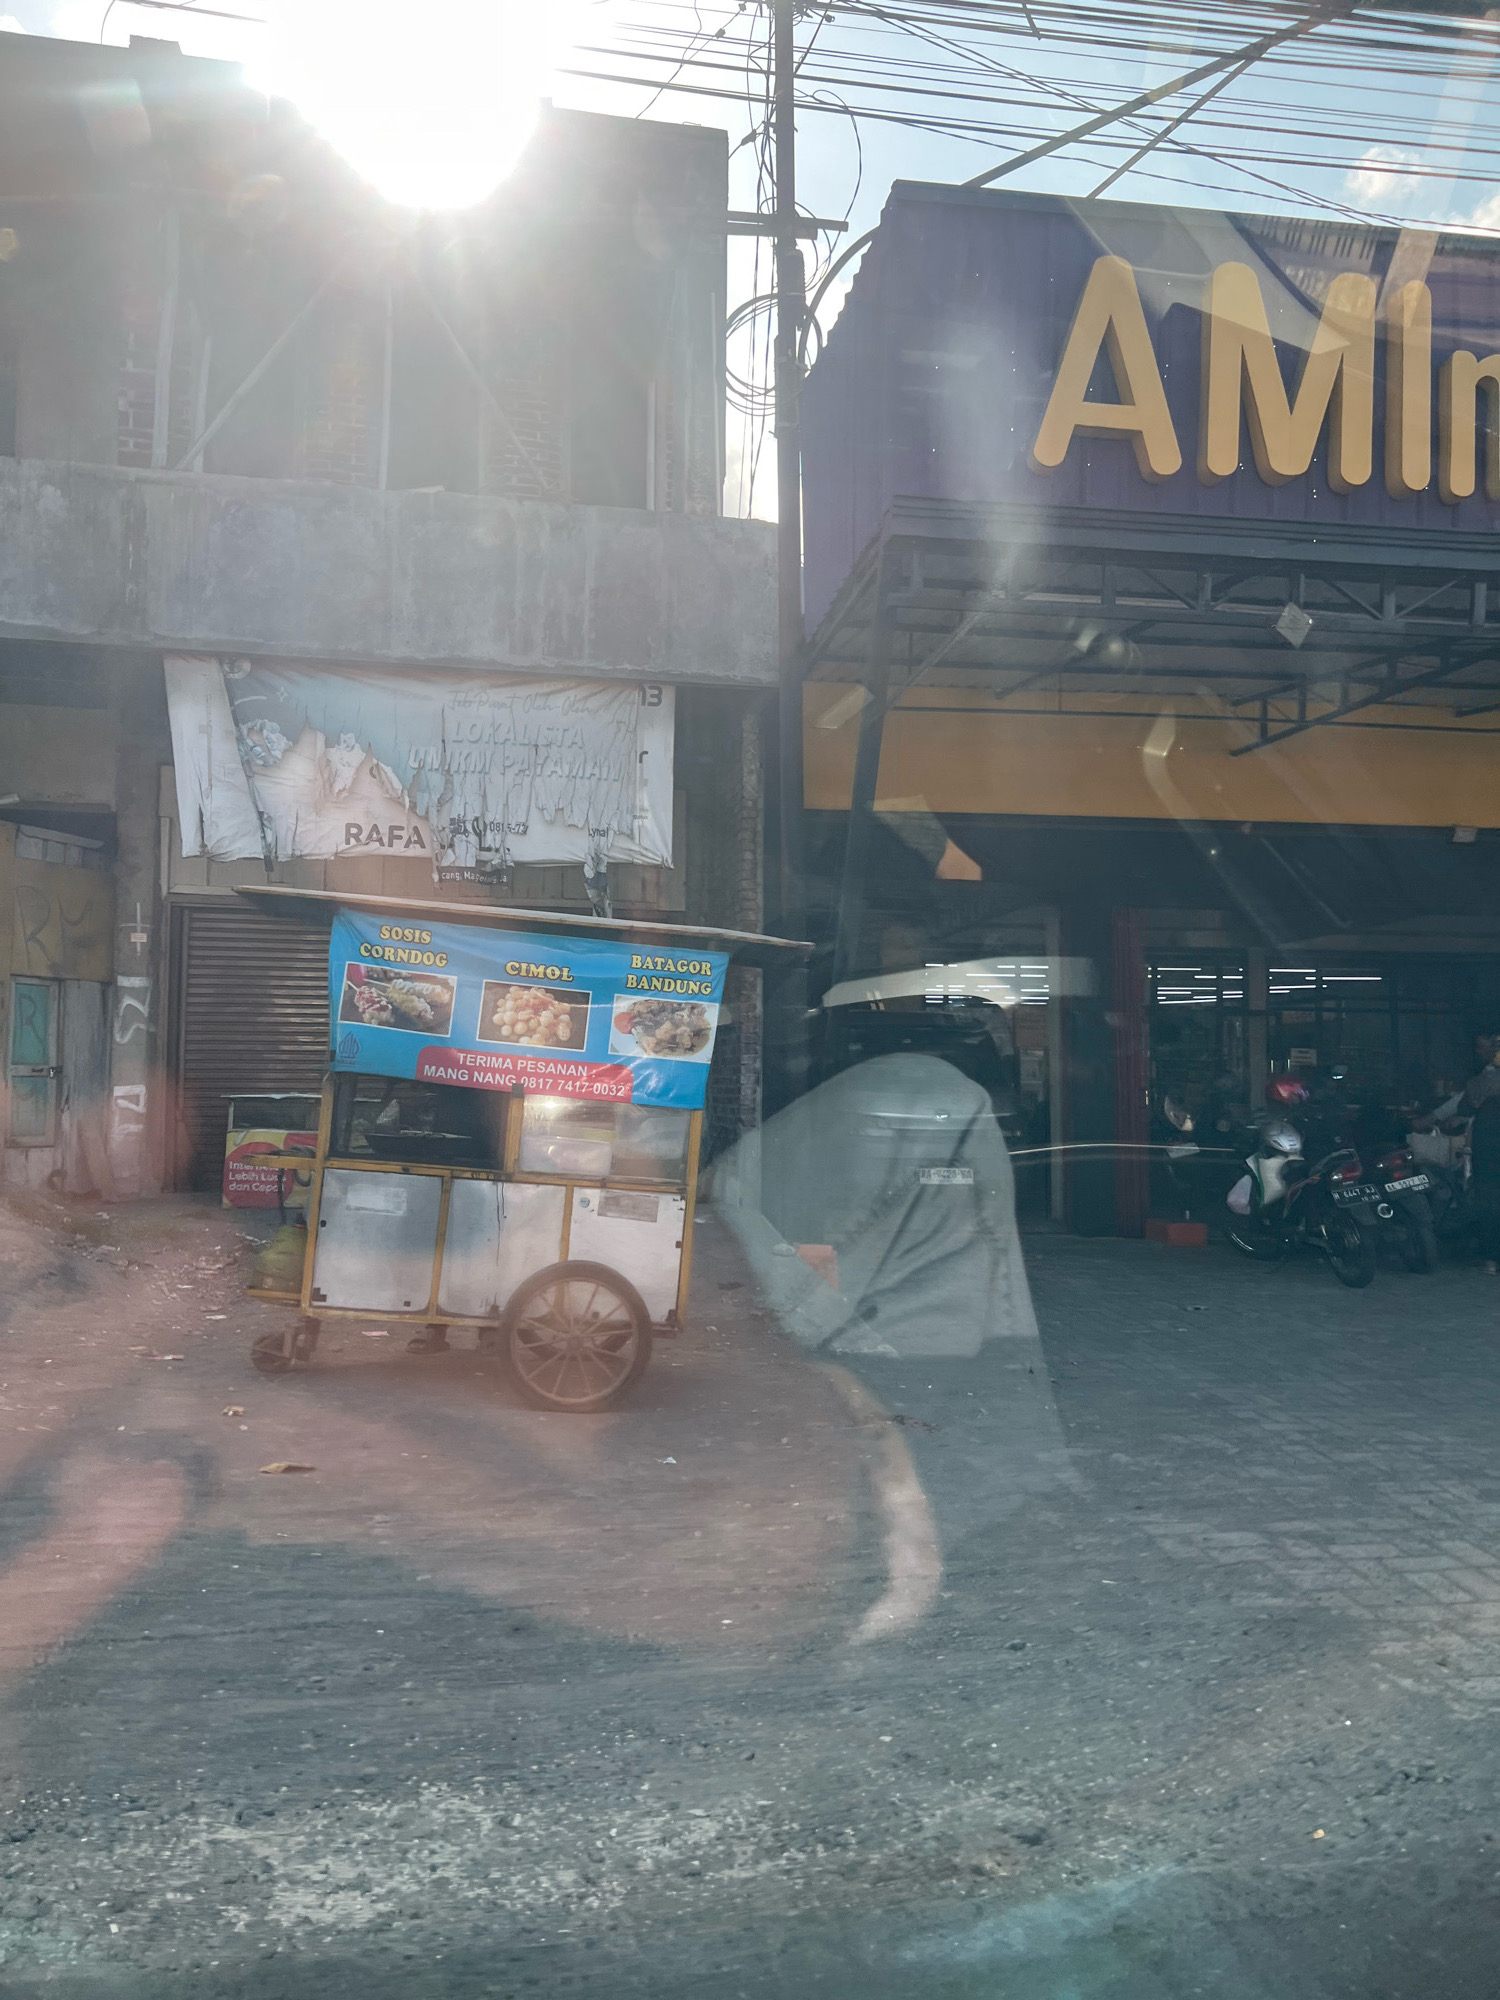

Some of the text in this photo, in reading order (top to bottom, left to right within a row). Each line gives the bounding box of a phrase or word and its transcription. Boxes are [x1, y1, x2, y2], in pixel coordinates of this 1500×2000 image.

[344, 822, 426, 849] RAFA
[380, 925, 432, 944] SOSIS
[359, 943, 448, 967] CORNDOG
[631, 954, 712, 976] BATAGOR
[505, 961, 574, 982] CIMOL
[626, 974, 712, 996] BANDUNG
[458, 1052, 513, 1071] TERIMA
[517, 1060, 588, 1078] PESANAN
[423, 1064, 625, 1098] MANG NANG 0817 7417 0032
